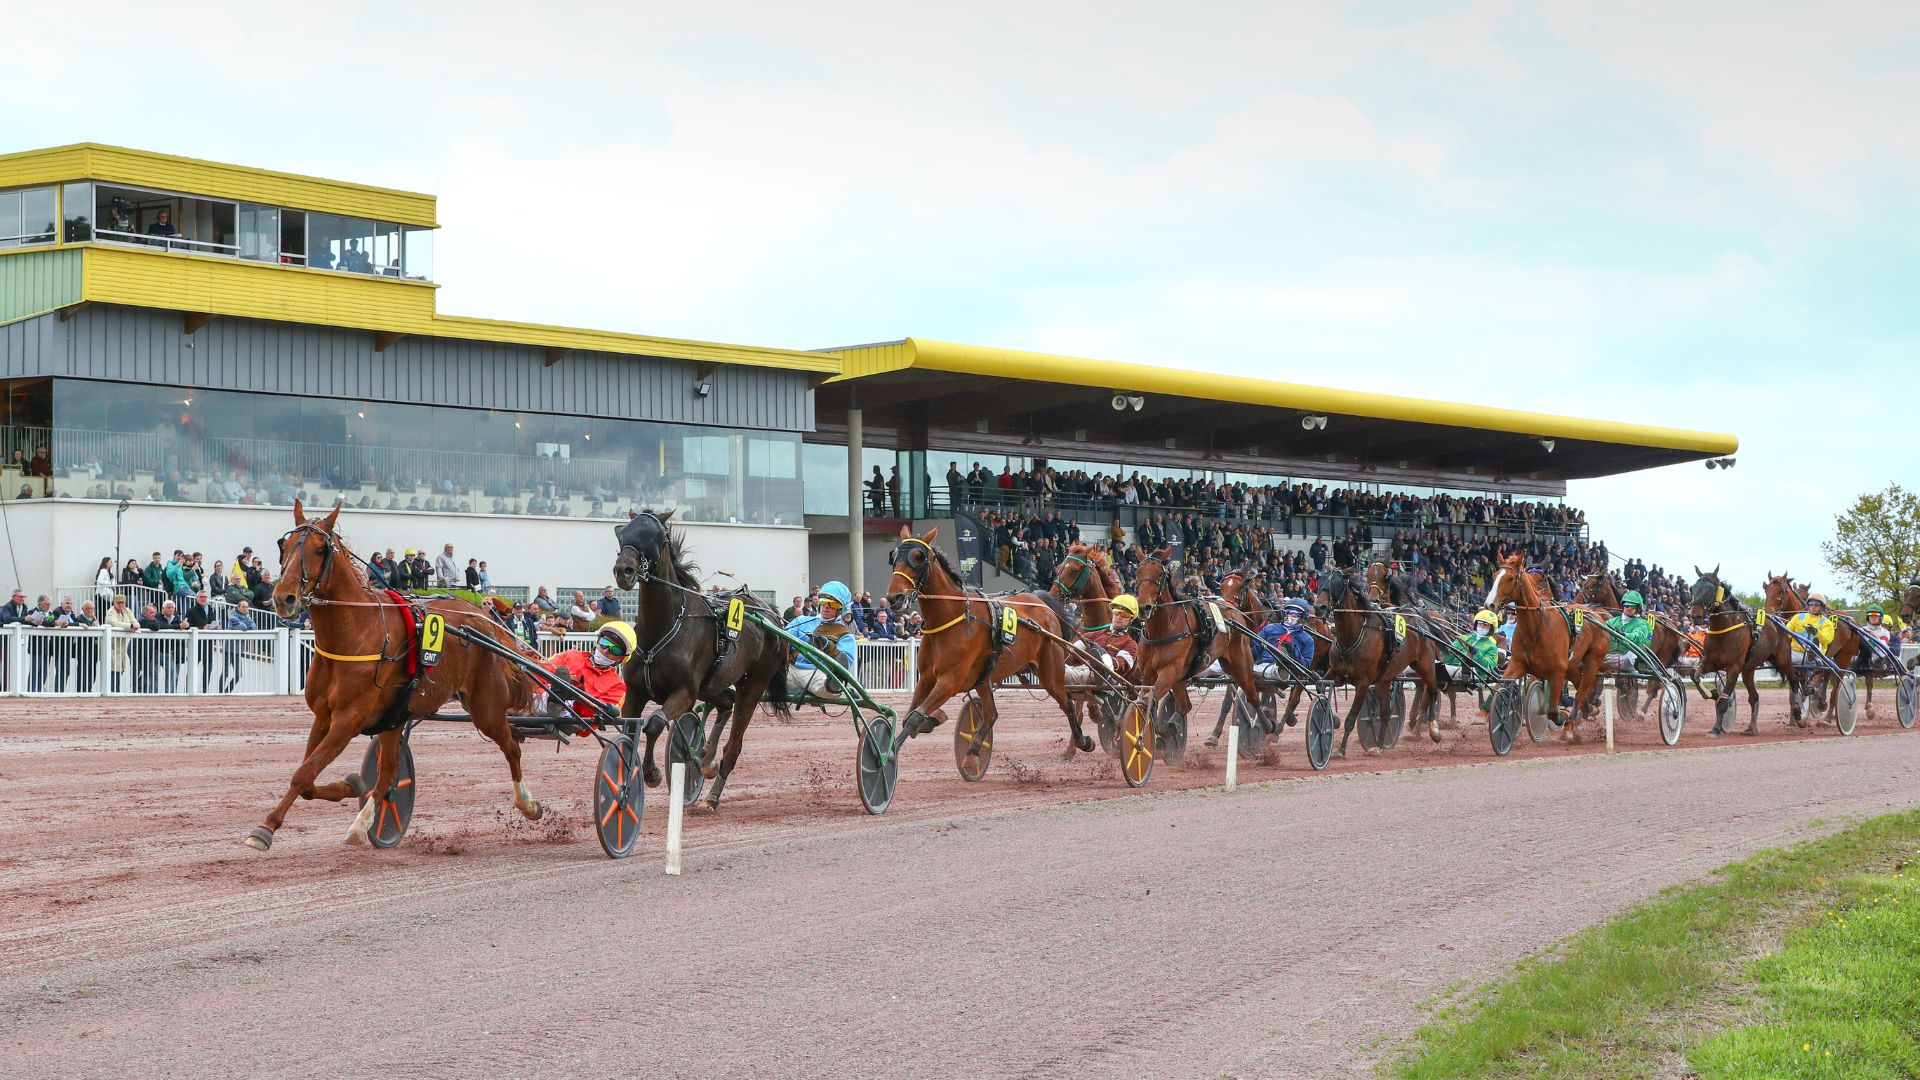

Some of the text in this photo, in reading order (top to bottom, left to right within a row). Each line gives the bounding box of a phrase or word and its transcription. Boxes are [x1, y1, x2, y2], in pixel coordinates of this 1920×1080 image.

[732, 602, 740, 627] 4
[1007, 609, 1014, 631] 5
[1575, 610, 1582, 625] 13
[1759, 611, 1763, 625] 1
[430, 617, 439, 648] 9
[1398, 618, 1404, 634] 6
[424, 652, 437, 662] GNT
